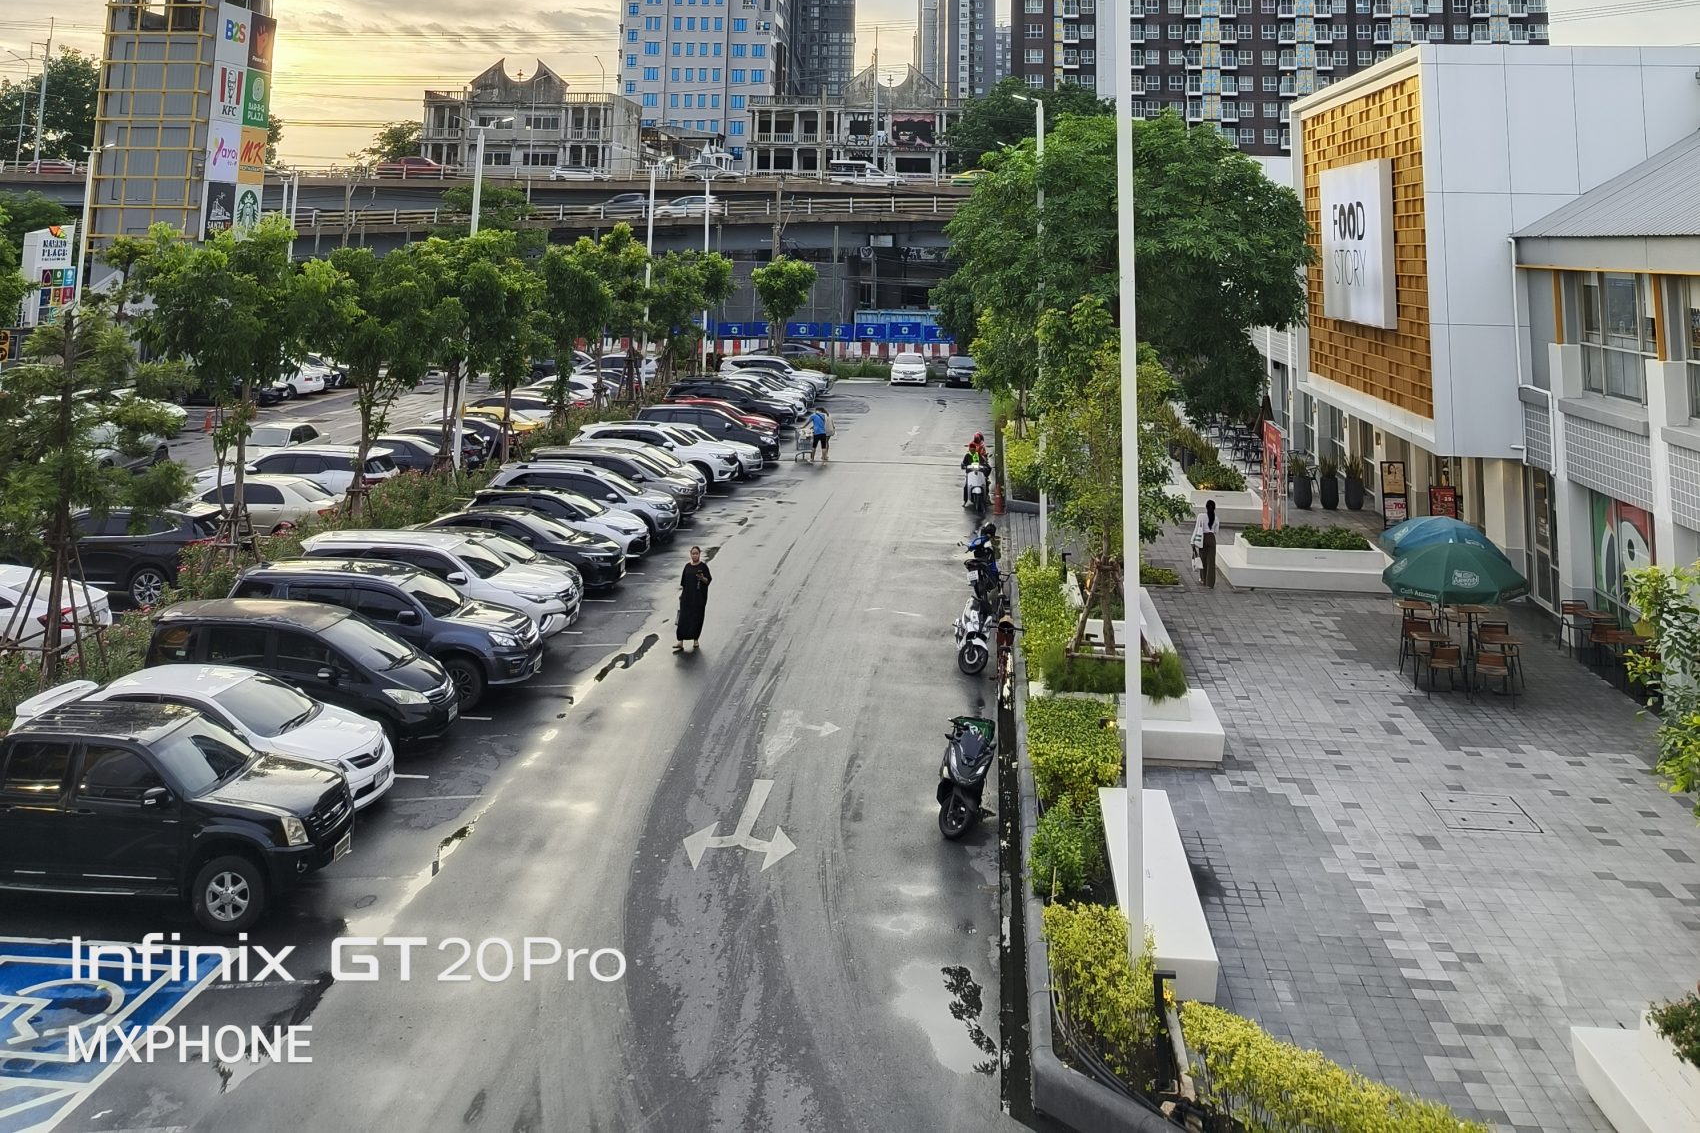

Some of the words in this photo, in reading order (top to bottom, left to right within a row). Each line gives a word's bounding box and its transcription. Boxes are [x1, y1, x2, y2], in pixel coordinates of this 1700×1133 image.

[225, 19, 246, 43] B2S
[222, 105, 237, 117] KFC
[247, 110, 264, 121] PLAZA
[240, 140, 265, 164] MK
[207, 221, 225, 230] SANTA
[1332, 201, 1366, 241] FOOD
[1334, 249, 1367, 287] STORY
